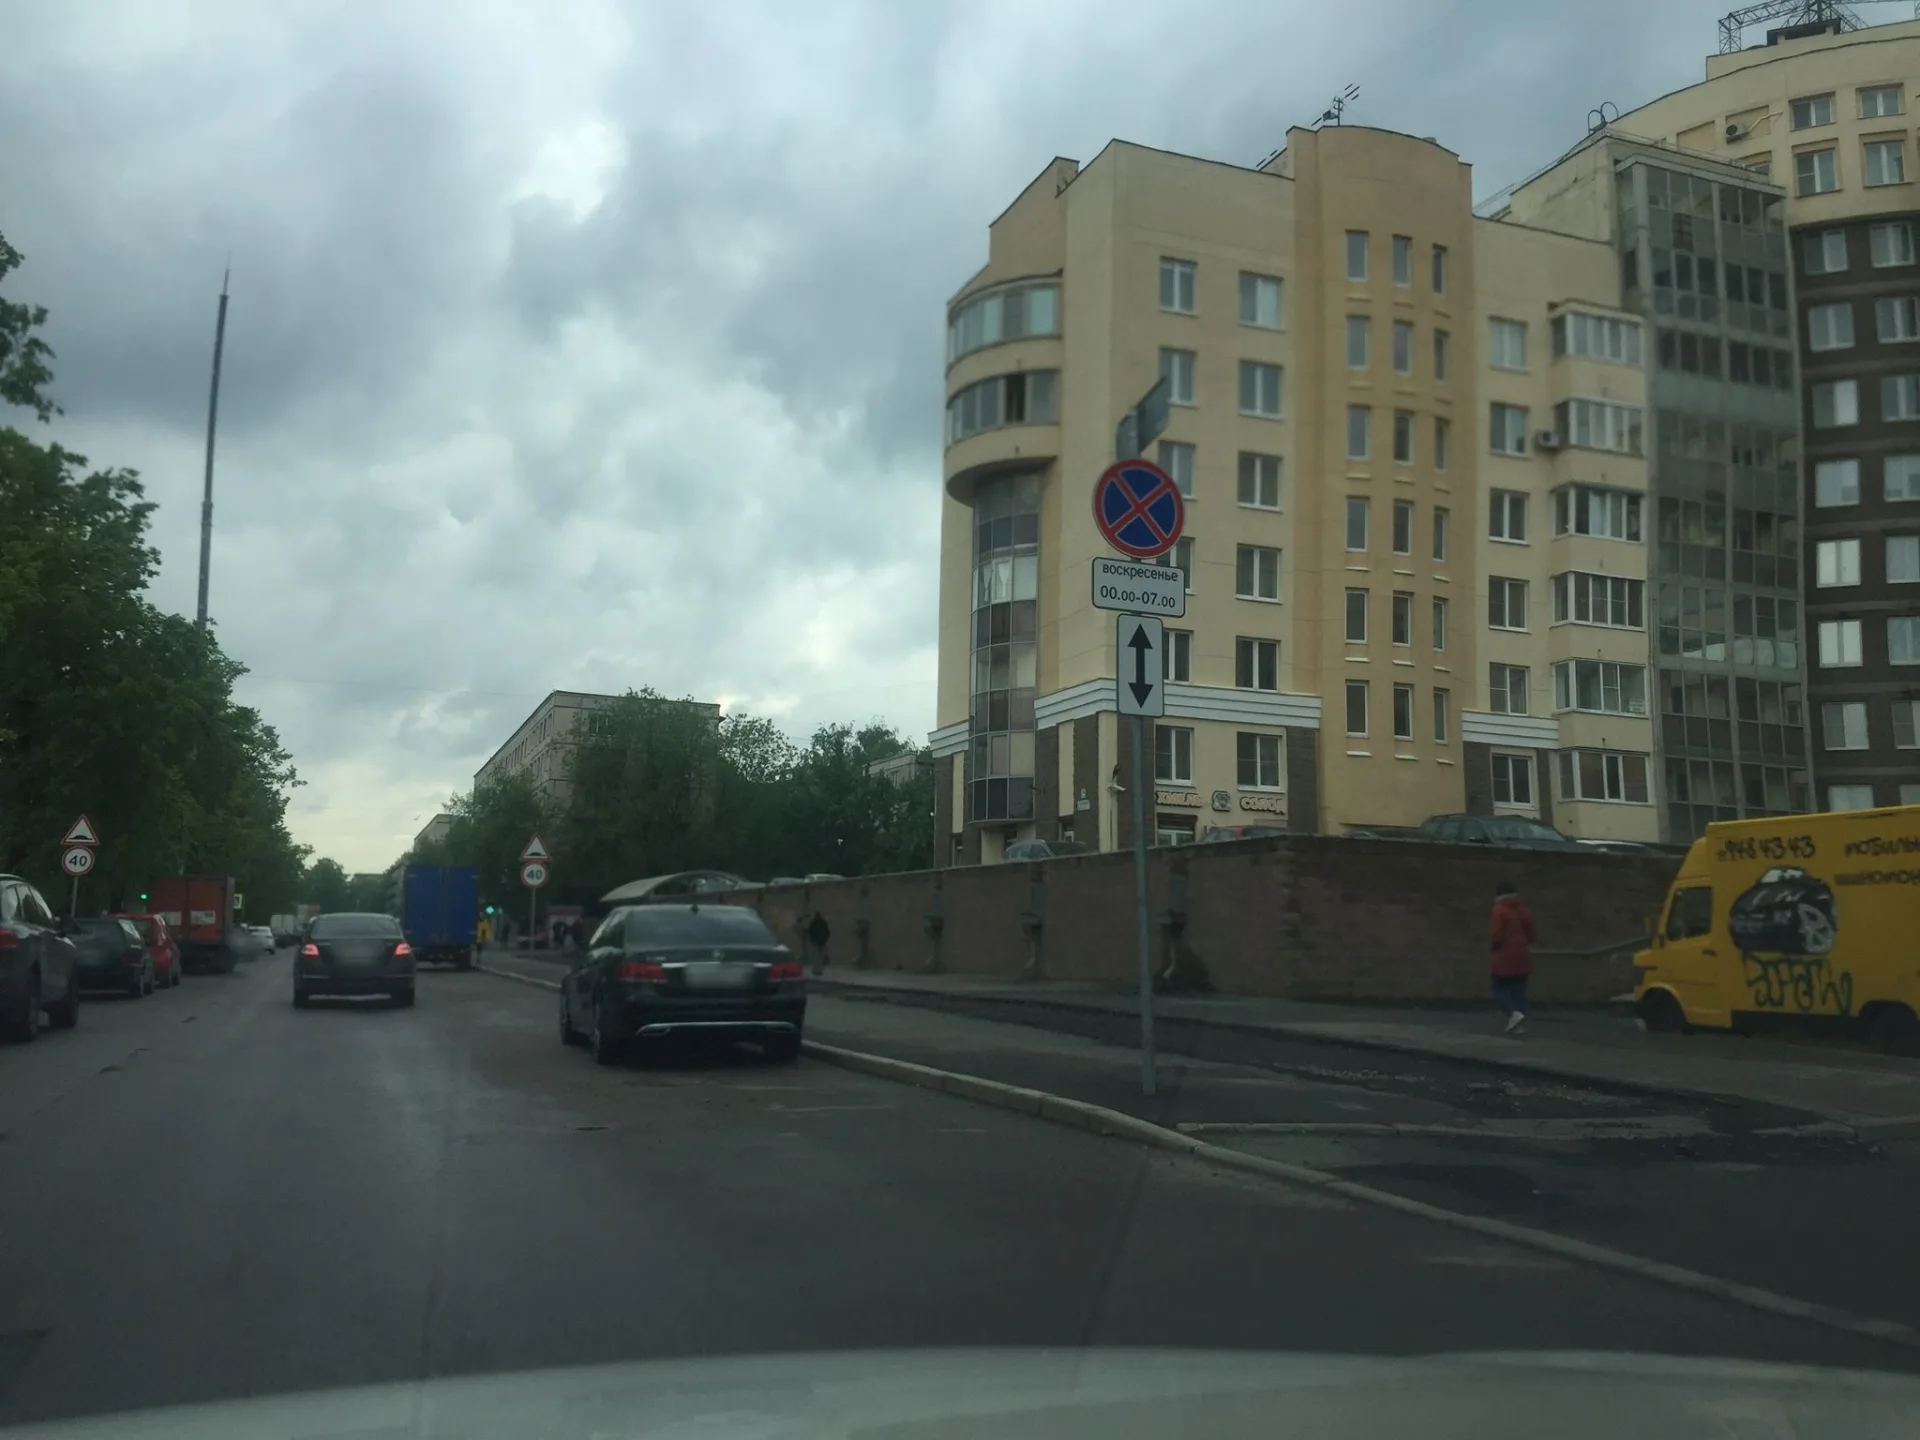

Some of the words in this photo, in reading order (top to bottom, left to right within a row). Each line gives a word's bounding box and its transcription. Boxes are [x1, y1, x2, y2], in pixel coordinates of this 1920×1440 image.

[1102, 563, 1179, 582] воскресенье
[1100, 585, 1176, 609] 00.00-07.00
[68, 855, 88, 867] 40
[526, 869, 543, 880] 40
